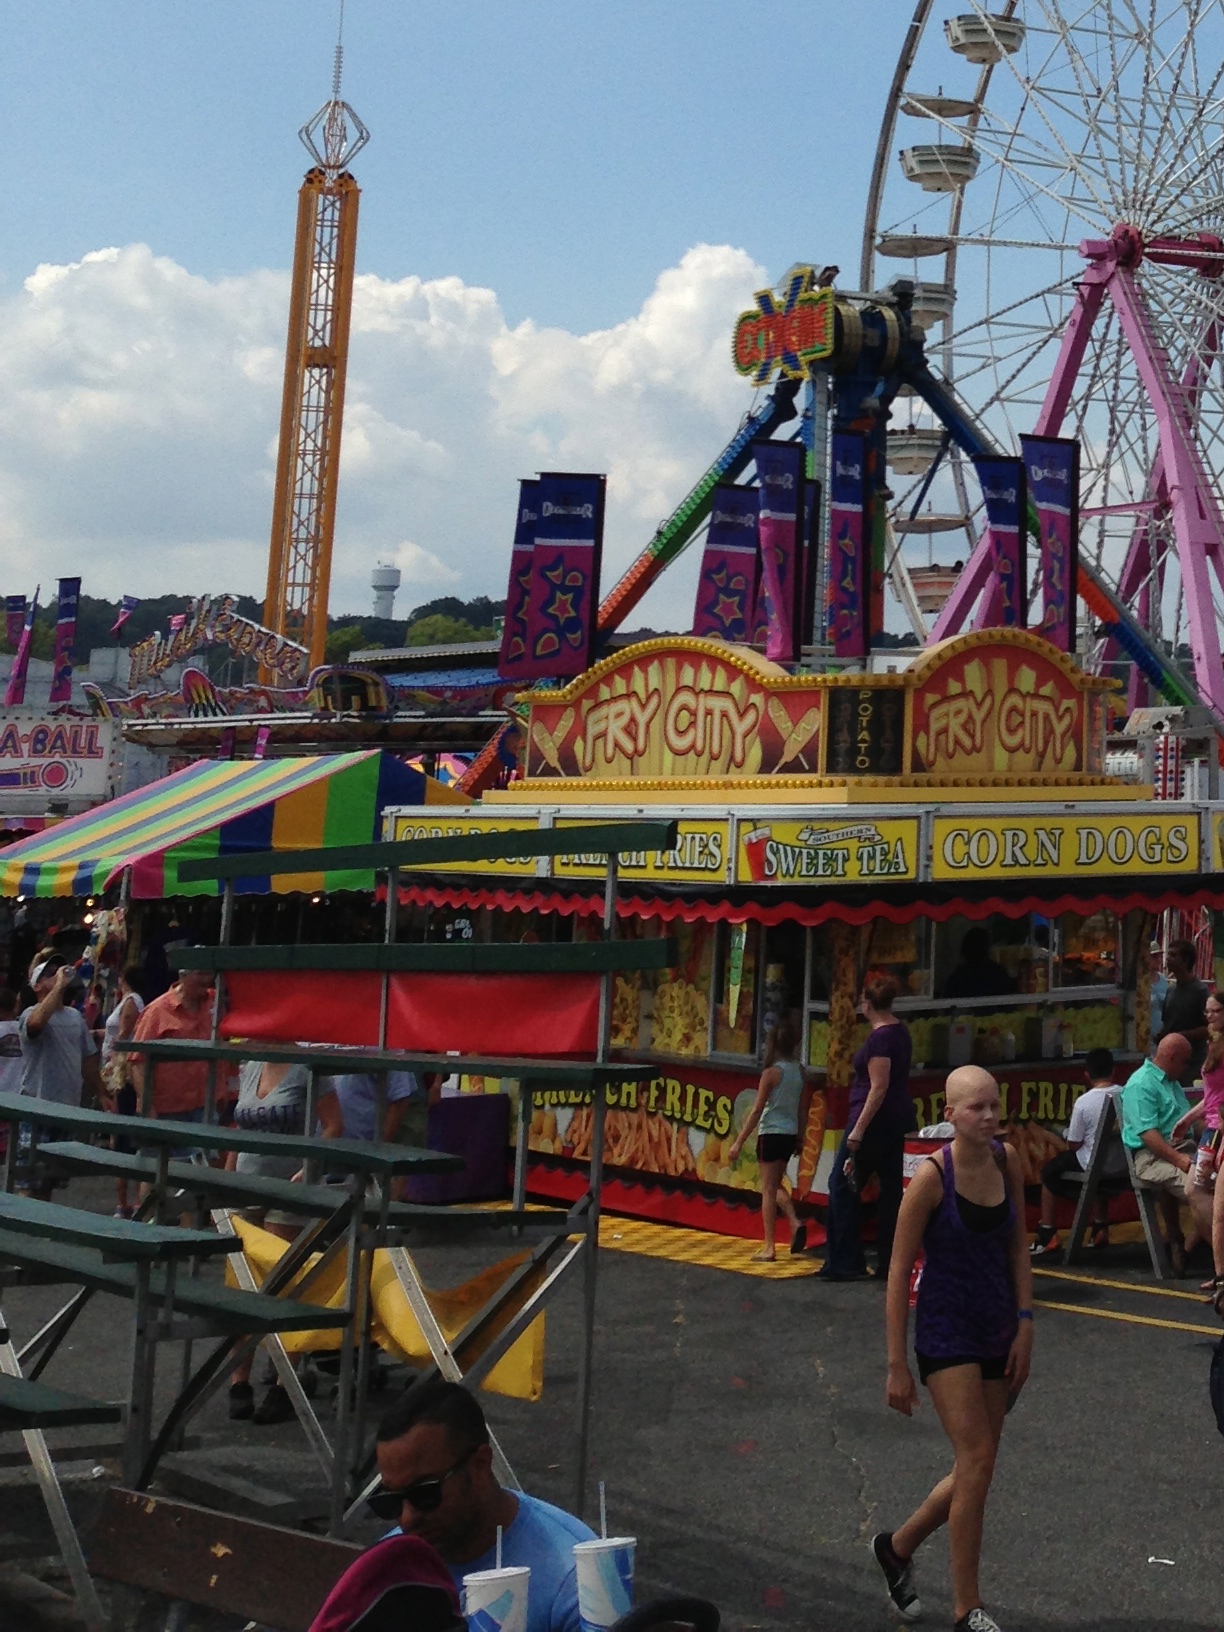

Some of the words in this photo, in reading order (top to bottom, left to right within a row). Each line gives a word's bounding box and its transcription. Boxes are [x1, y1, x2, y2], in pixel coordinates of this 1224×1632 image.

[584, 689, 662, 771] FRY
[664, 685, 759, 768] CITY
[857, 690, 873, 769] POTATO
[926, 689, 993, 767] FRY
[999, 688, 1077, 765] CITY
[764, 840, 849, 877] SWEET
[857, 838, 908, 876] TEA
[811, 826, 873, 843] SOUTHERN
[943, 827, 1062, 868] CORN
[1078, 824, 1190, 866] DOGS
[648, 1076, 732, 1135] FRIES
